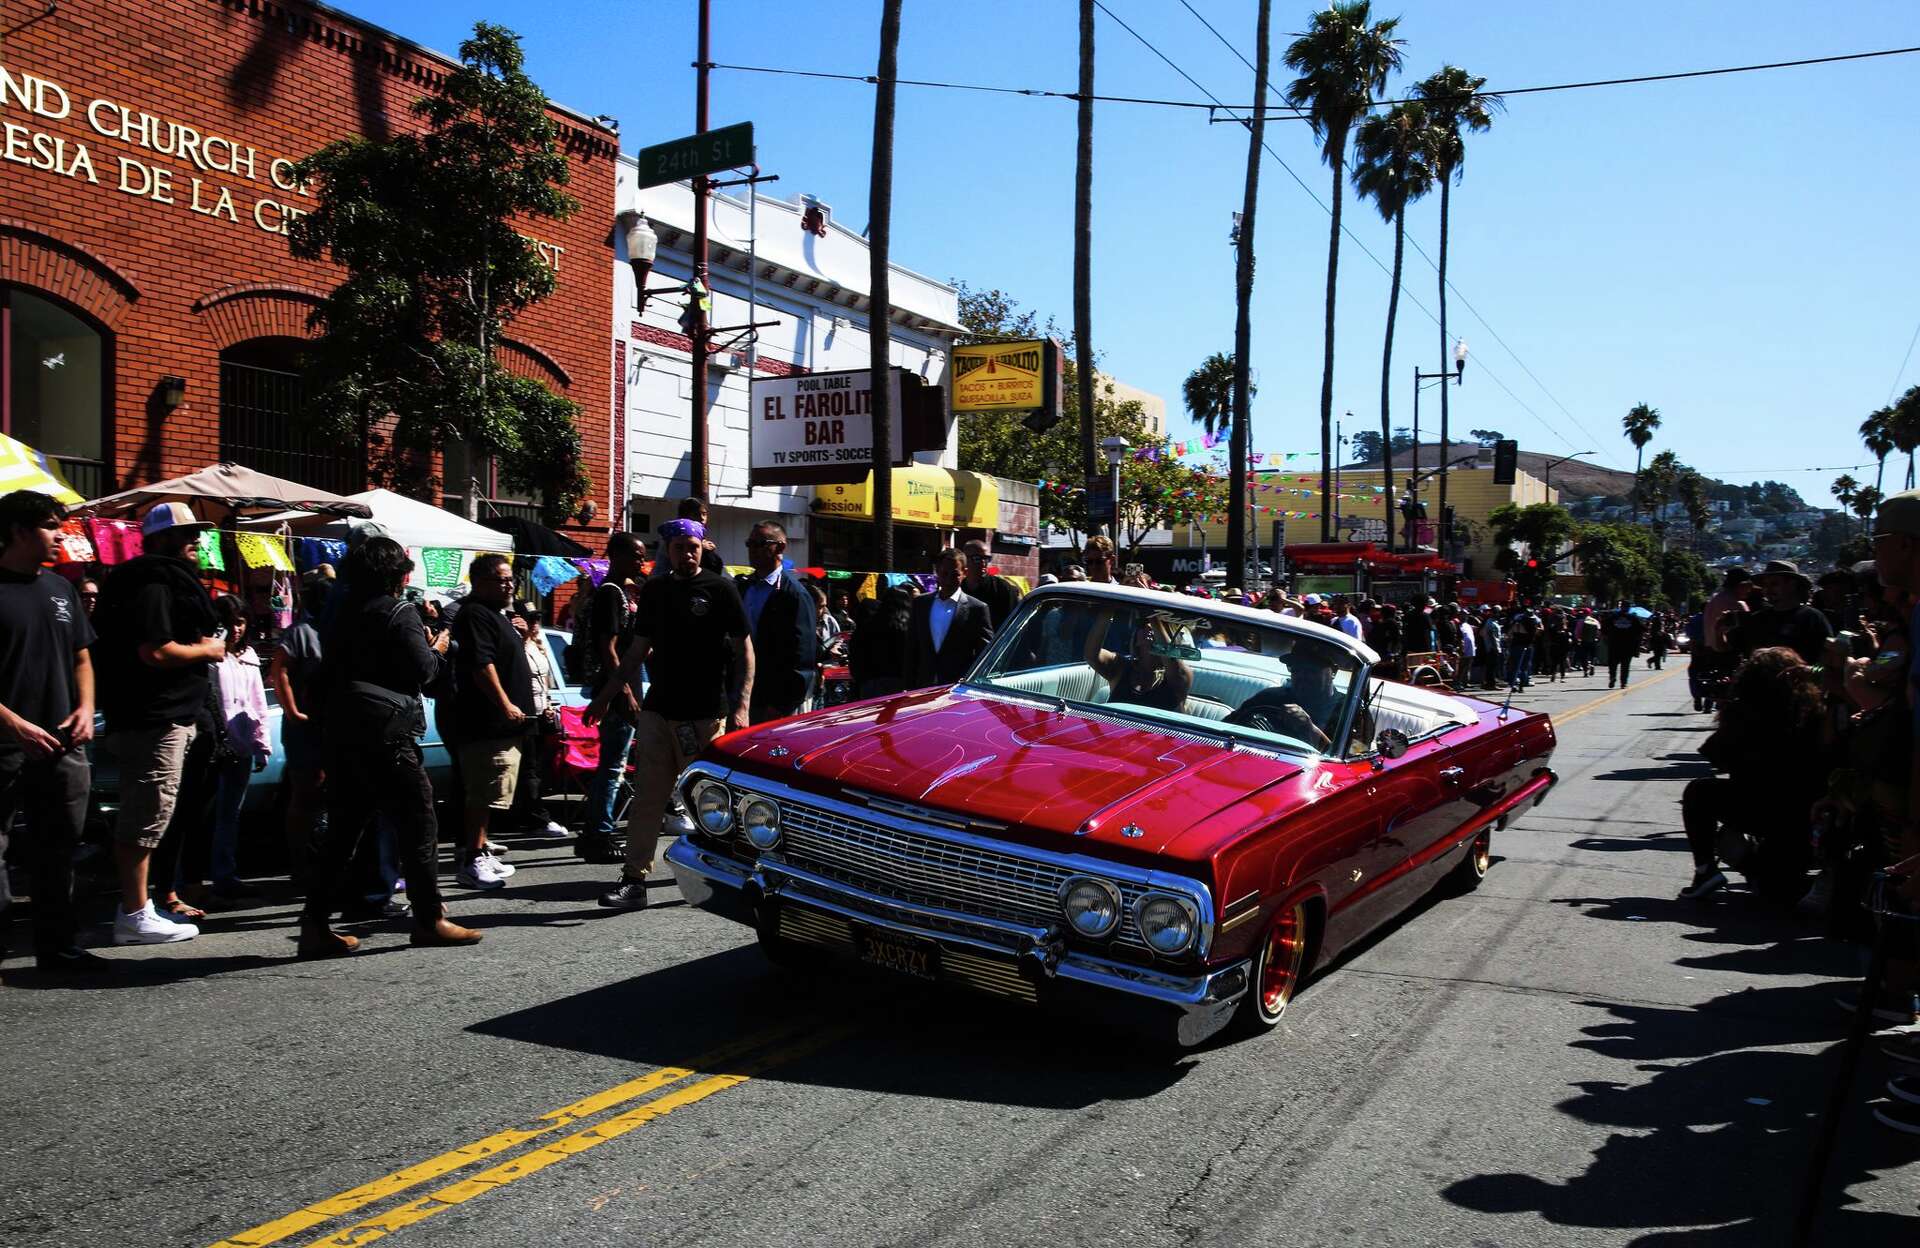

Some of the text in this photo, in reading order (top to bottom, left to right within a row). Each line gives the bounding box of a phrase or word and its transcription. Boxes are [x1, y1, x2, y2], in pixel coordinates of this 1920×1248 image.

[88, 99, 256, 179] CHURCH
[0, 121, 99, 184] ESIA
[117, 155, 174, 204] DE
[190, 177, 239, 223] LA
[657, 138, 732, 175] 24th St
[797, 376, 851, 392] POOL TABLE
[764, 389, 873, 420] EL FAROLIT
[805, 419, 845, 445] BAR
[773, 452, 787, 463] TV
